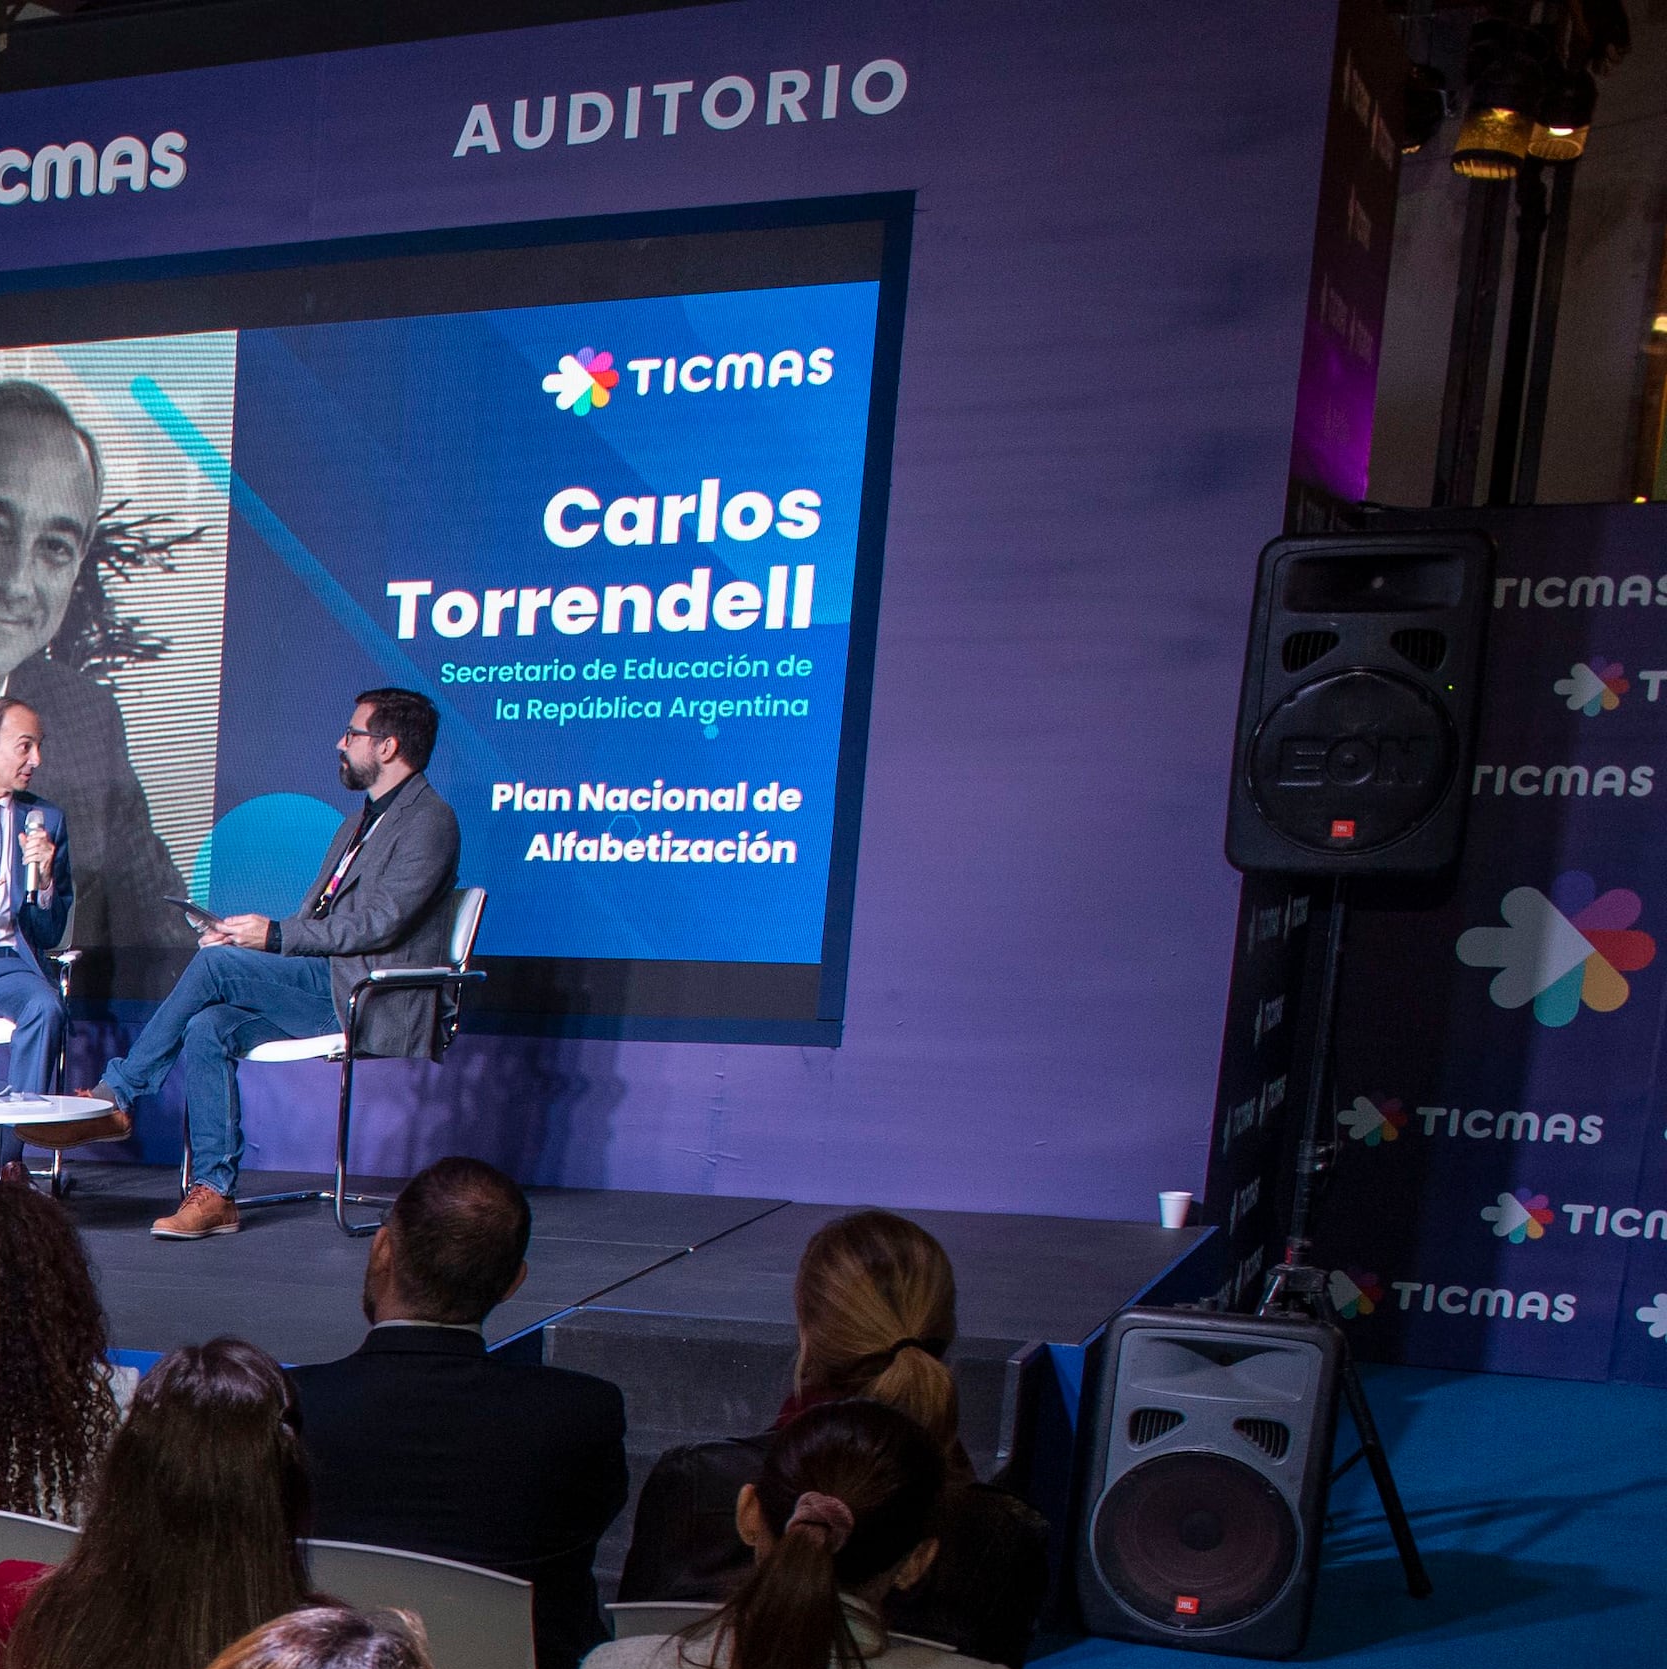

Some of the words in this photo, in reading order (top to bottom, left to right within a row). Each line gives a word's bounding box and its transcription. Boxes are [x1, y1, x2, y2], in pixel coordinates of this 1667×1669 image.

[451, 56, 909, 160] AUDITORIO
[627, 347, 834, 396] TICMAS
[543, 478, 822, 549] Carlos
[386, 564, 815, 640] Torrendell
[441, 658, 576, 685] Secretario
[582, 658, 617, 681] de
[624, 654, 769, 680] Educación
[775, 654, 813, 677] de
[495, 698, 521, 720] la
[526, 695, 662, 726] República
[668, 694, 809, 725] Argentina
[491, 781, 570, 812] Plan
[578, 779, 746, 812] Nacional
[752, 781, 803, 811] de
[1471, 764, 1655, 798] TICMAS
[524, 830, 797, 864] Alfabetización
[1416, 1106, 1604, 1145] TICMAS
[1391, 1281, 1576, 1323] TICMAS
